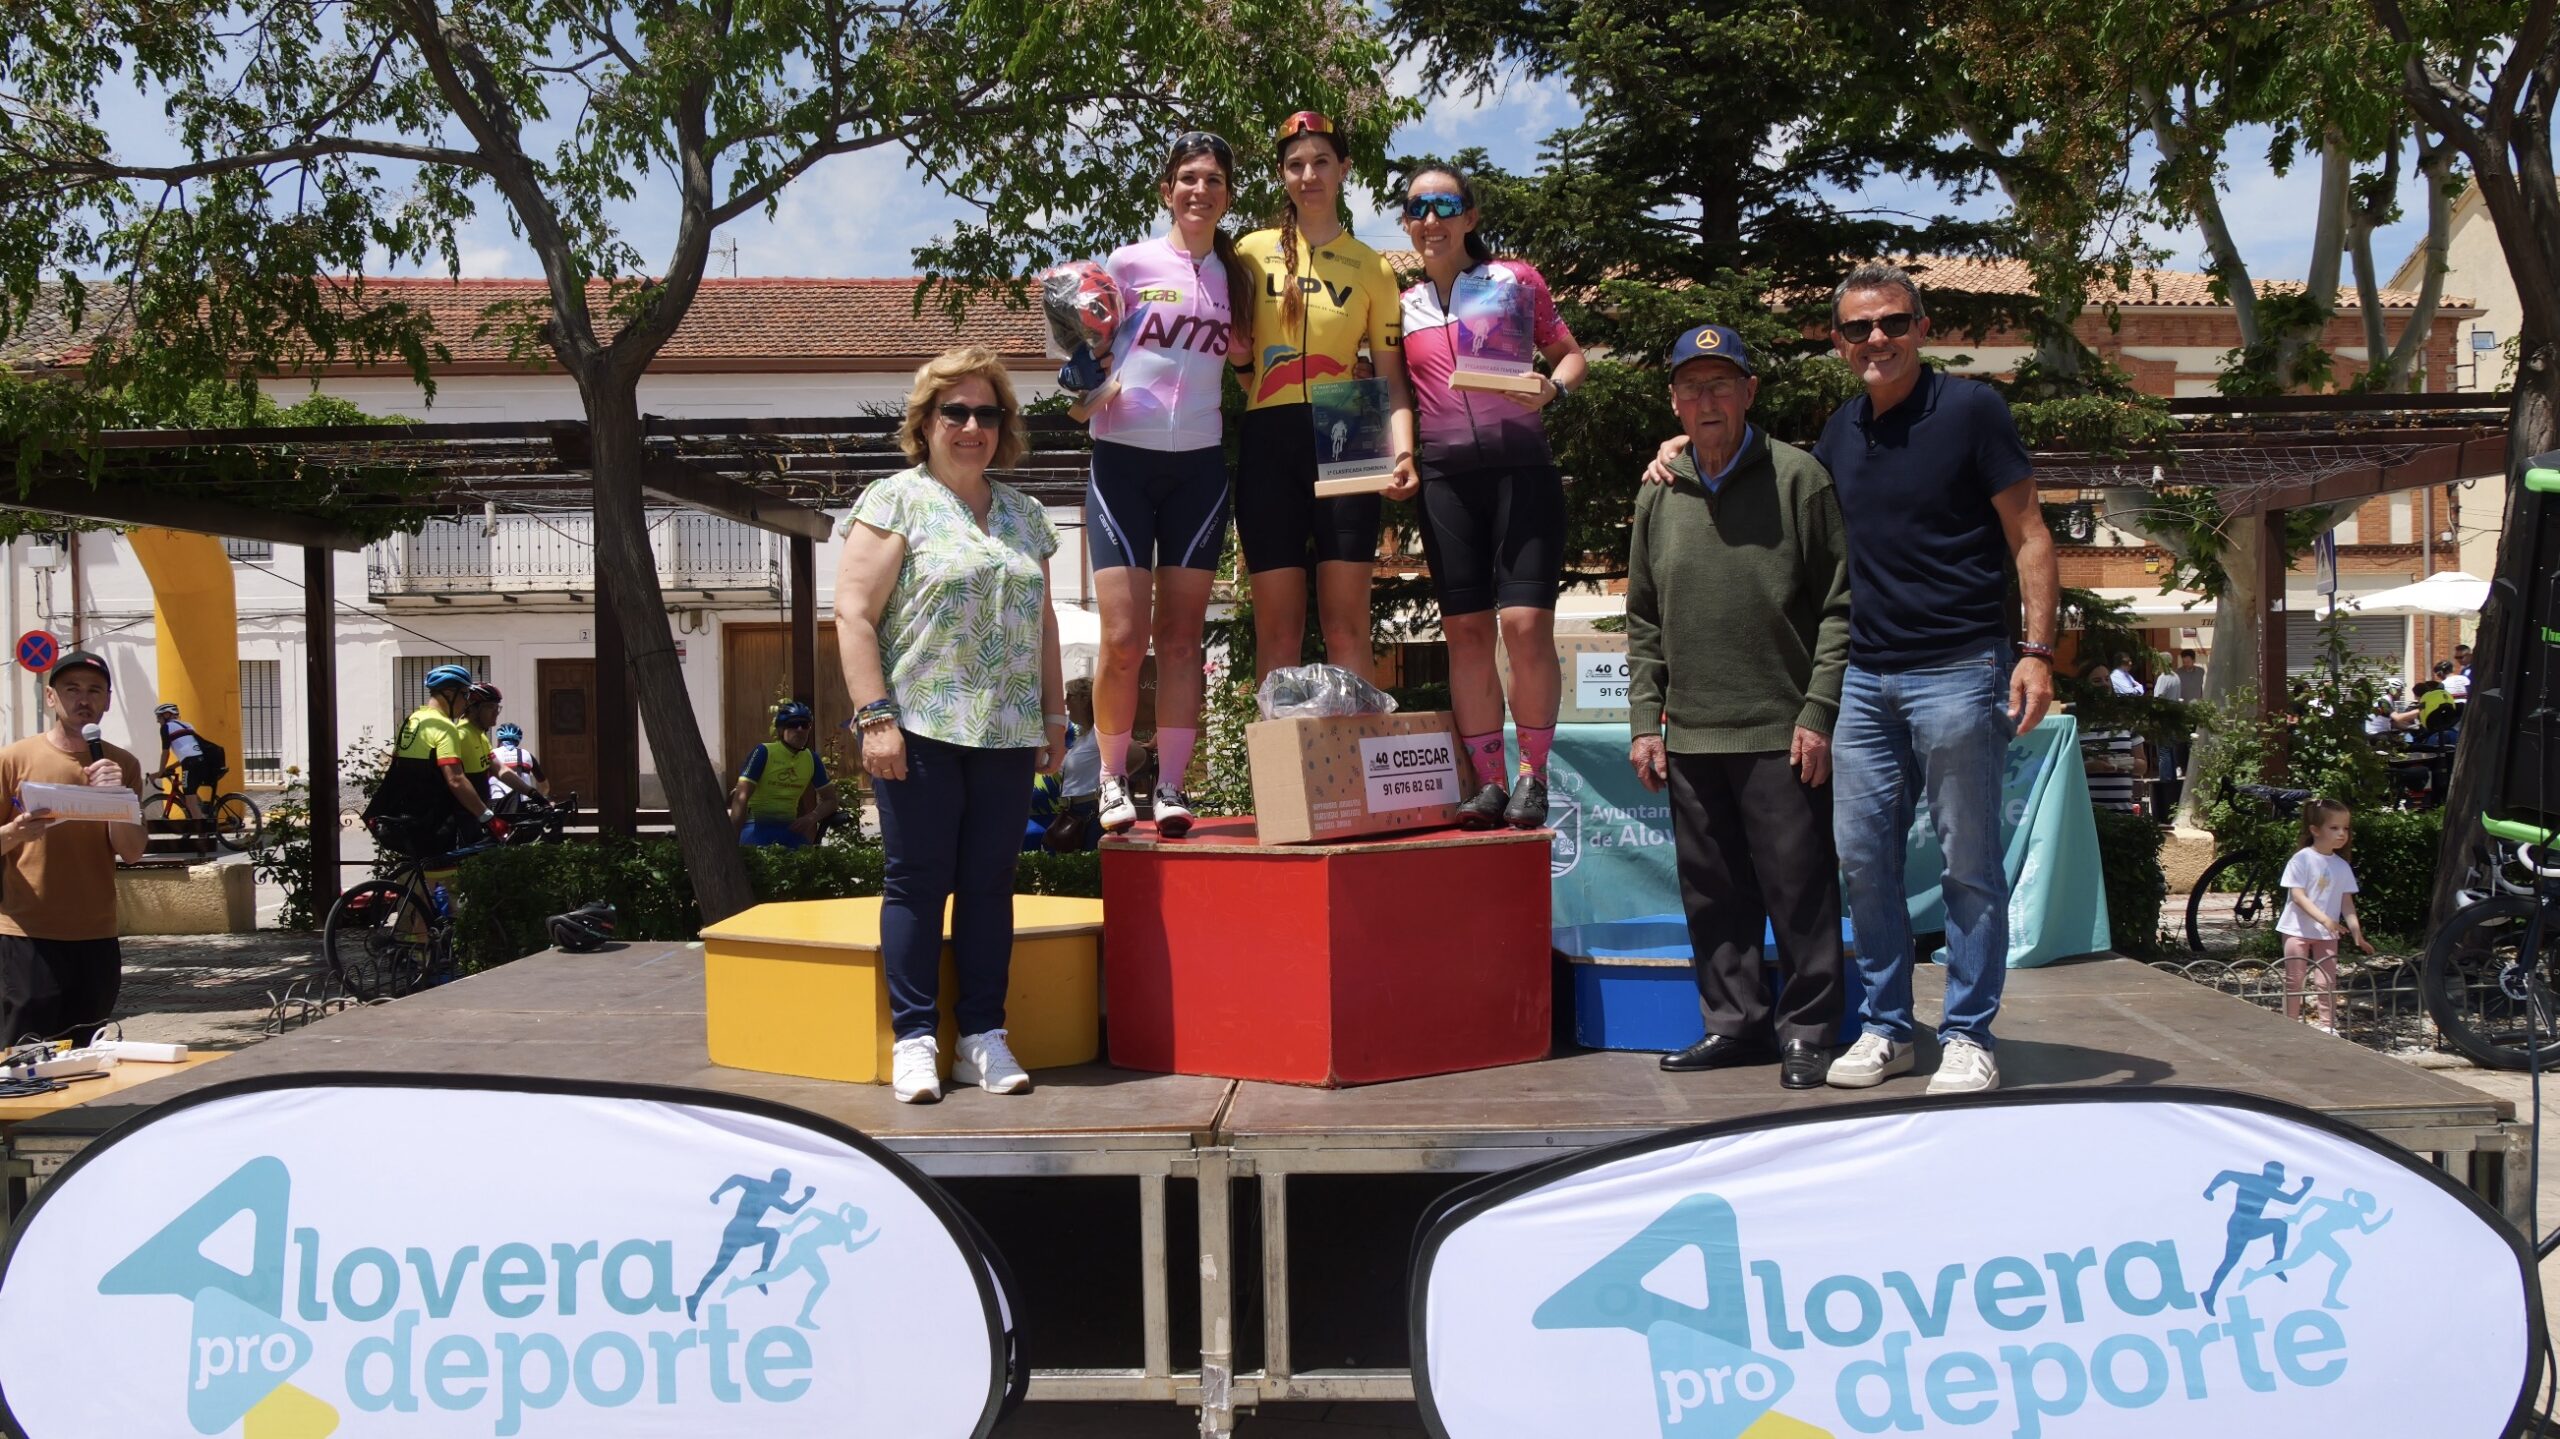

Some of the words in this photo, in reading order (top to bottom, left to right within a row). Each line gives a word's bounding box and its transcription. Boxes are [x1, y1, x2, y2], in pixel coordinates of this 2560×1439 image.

[1266, 273, 1352, 308] UPV
[1600, 687, 1612, 697] 91
[1615, 687, 1629, 697] 67
[1376, 752, 1388, 764] 40
[1393, 747, 1449, 768] CEDECAR
[1383, 783, 1393, 796] 91
[1395, 781, 1411, 795] 676
[1412, 780, 1423, 793] 82
[1425, 779, 1435, 791] 62
[1590, 831, 1612, 848] de
[1618, 824, 1675, 847] Alov
[195, 1332, 297, 1390] pro
[345, 1303, 813, 1437] deporte
[1835, 1295, 2349, 1439] deporte
[1660, 1362, 1776, 1424] pro
